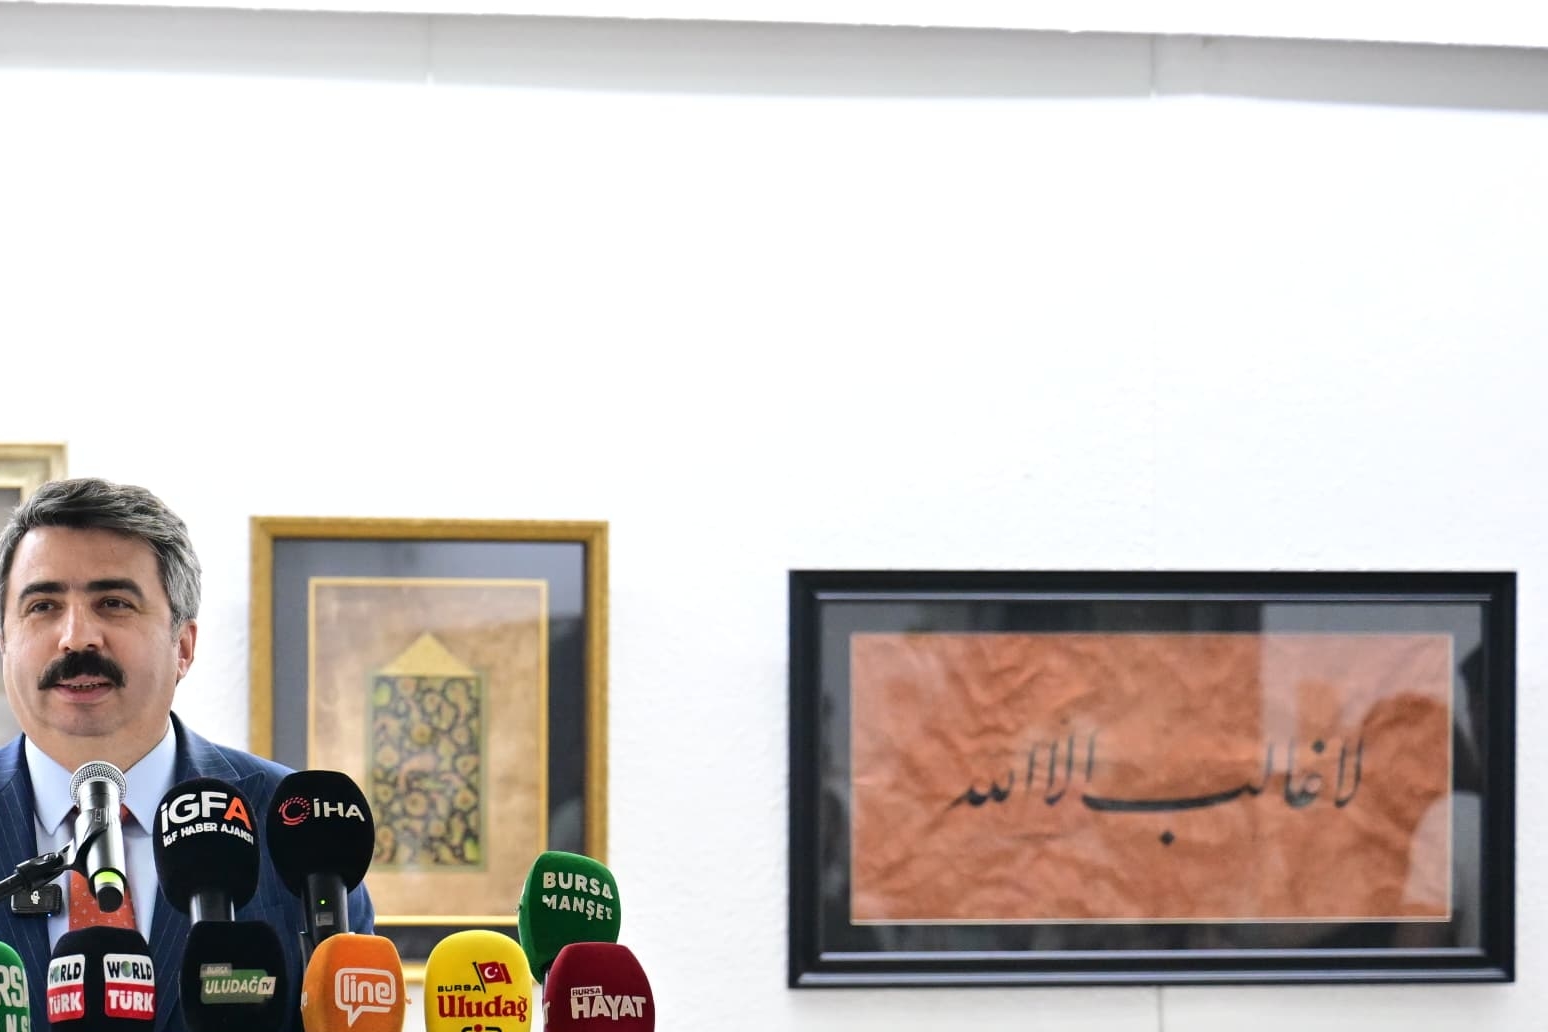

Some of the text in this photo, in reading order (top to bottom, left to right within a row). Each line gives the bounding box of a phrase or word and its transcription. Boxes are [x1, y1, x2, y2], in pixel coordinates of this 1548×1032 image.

[180, 822, 218, 838] HABER
[543, 871, 614, 900] BURSA
[542, 894, 613, 920] MANŞET
[107, 960, 152, 980] WORLD
[205, 976, 258, 994] ULUDAĞ
[572, 987, 602, 996] BURSA
[49, 991, 83, 1015] TÜRK
[108, 989, 154, 1012] TÜRK
[437, 995, 528, 1022] Uludağ
[570, 994, 646, 1021] HAYAT
